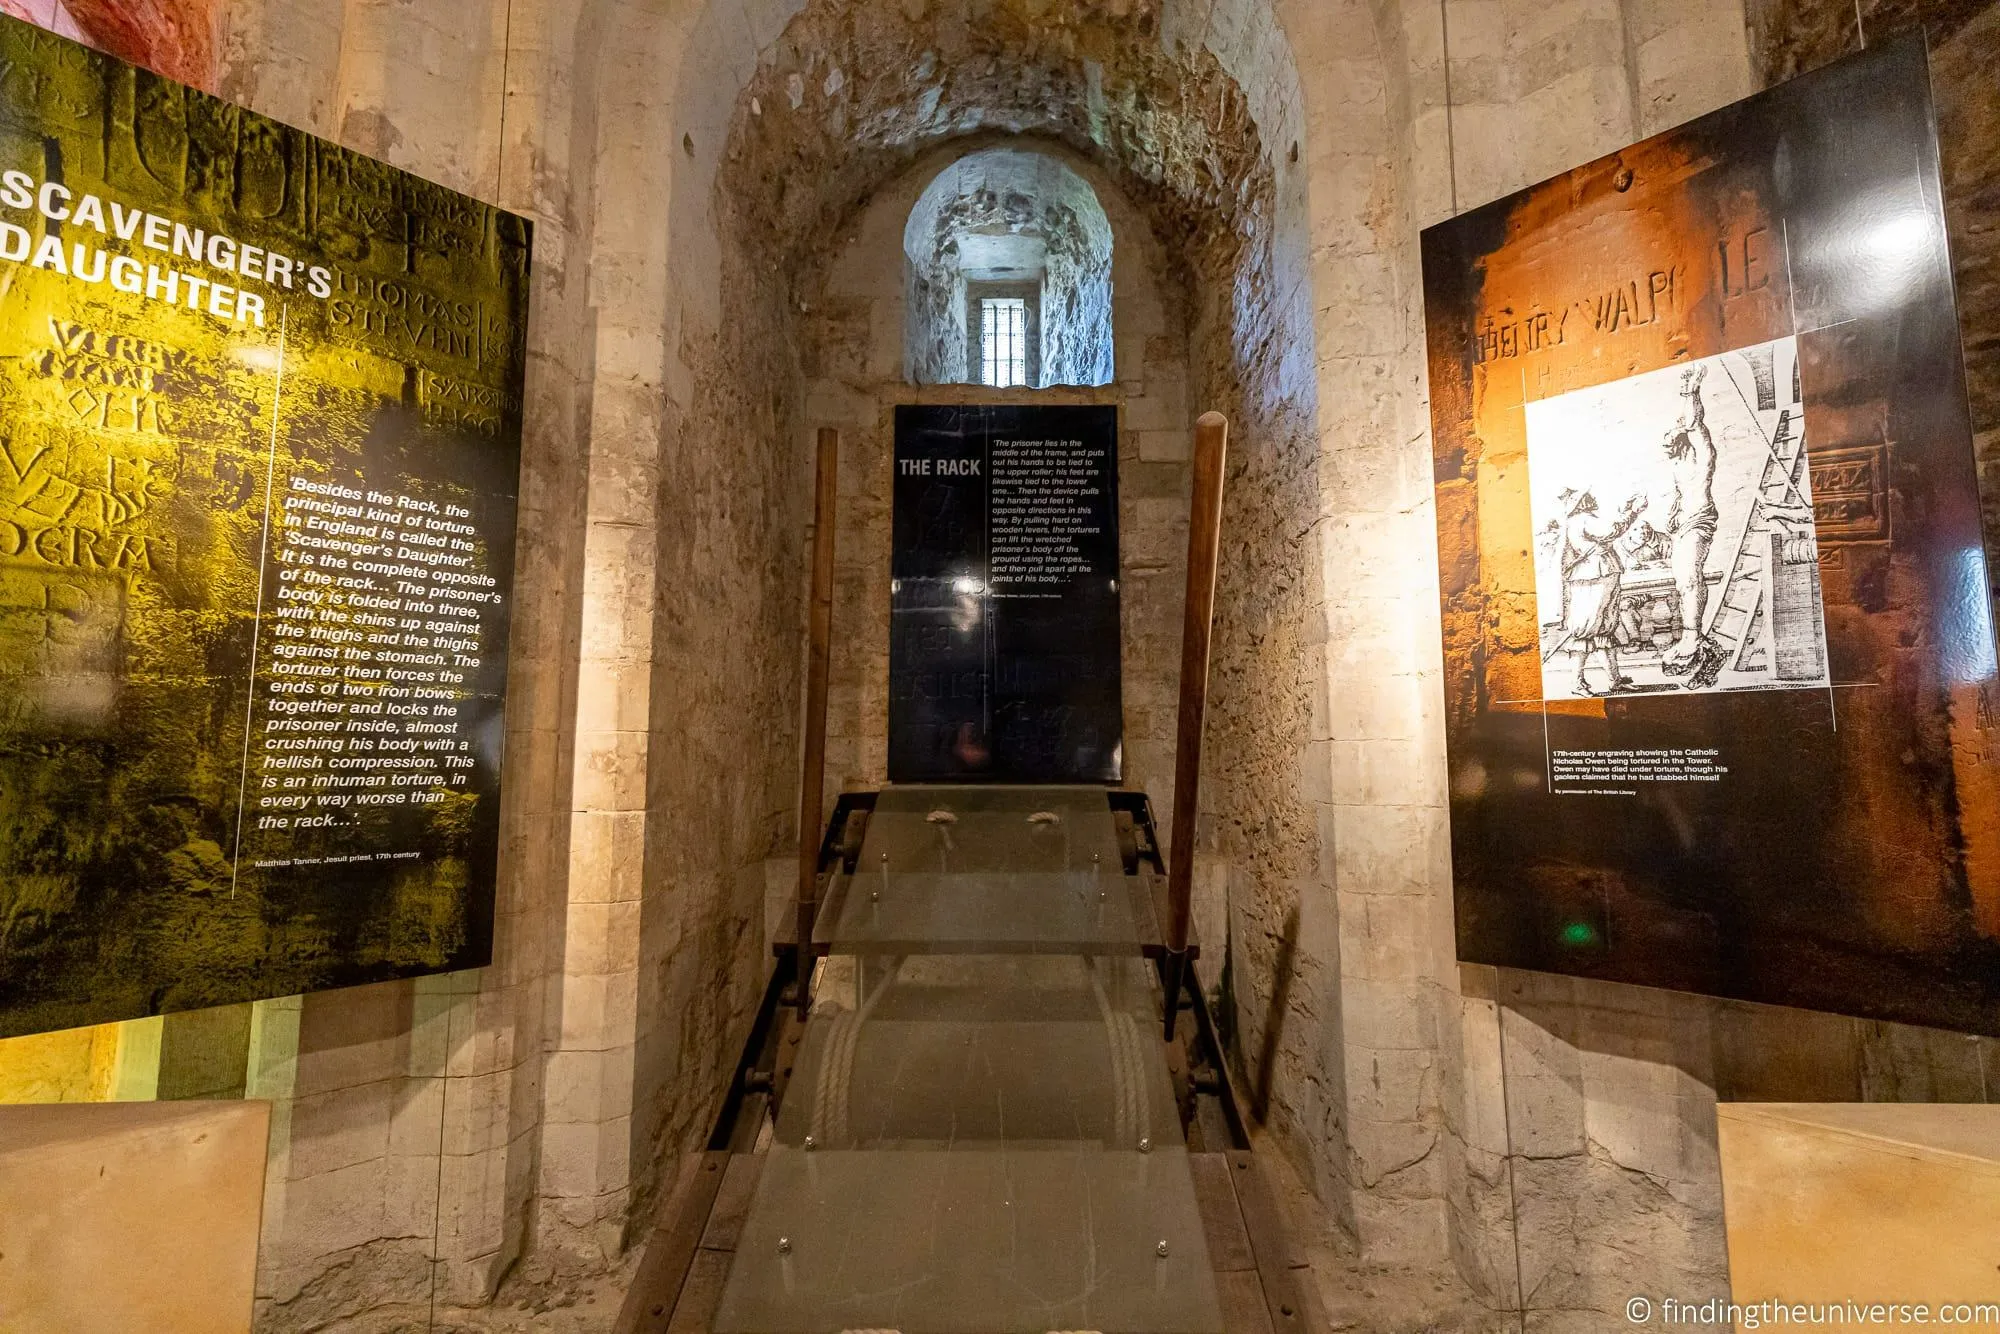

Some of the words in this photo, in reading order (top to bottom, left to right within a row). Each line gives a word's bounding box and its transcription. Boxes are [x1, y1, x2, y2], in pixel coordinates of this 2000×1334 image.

[1, 170, 332, 299] SCAVENGER'S
[0, 222, 265, 328] DAUGHTER
[900, 459, 931, 475] THE
[936, 459, 981, 475] RACK
[397, 496, 440, 515] Rack,
[285, 497, 362, 519] principal
[364, 507, 402, 524] kind
[426, 518, 474, 535] torture
[306, 516, 377, 538] England
[399, 533, 447, 547] called
[352, 561, 427, 578] complete
[432, 571, 495, 586] opposite
[398, 581, 425, 595] The
[278, 586, 324, 604] body
[348, 594, 401, 609] folded
[404, 599, 434, 613] into
[438, 603, 480, 619] three,
[277, 606, 313, 619] with
[353, 612, 396, 626] shins
[425, 621, 480, 634] against
[310, 626, 363, 643] thighs
[368, 633, 400, 644] and
[433, 636, 479, 652] thighs
[273, 644, 340, 658] against
[375, 650, 447, 667] stomach.
[454, 654, 480, 667] The
[272, 661, 339, 678] torturer
[344, 665, 381, 678] then
[386, 667, 435, 684] forces
[270, 681, 315, 693] ends
[343, 682, 373, 696] two
[378, 685, 410, 698] iron
[413, 685, 454, 699] bows
[269, 698, 346, 714] together
[350, 702, 382, 714] and
[386, 702, 428, 715] locks
[265, 718, 342, 733] prisoner
[346, 719, 399, 734] inside,
[406, 721, 458, 733] almost
[265, 737, 344, 752] crushing
[349, 737, 374, 750] his
[378, 738, 421, 753] body
[424, 738, 455, 750] with
[1636, 749, 1668, 757] showing
[263, 755, 322, 768] hellish
[329, 756, 437, 770] compression.
[445, 756, 474, 767] This
[1684, 766, 1713, 774] though
[312, 774, 386, 786] inhuman
[391, 774, 446, 786] torture,
[260, 796, 312, 809] every
[317, 795, 352, 808] way
[356, 794, 405, 804] worse
[411, 789, 445, 802] than
